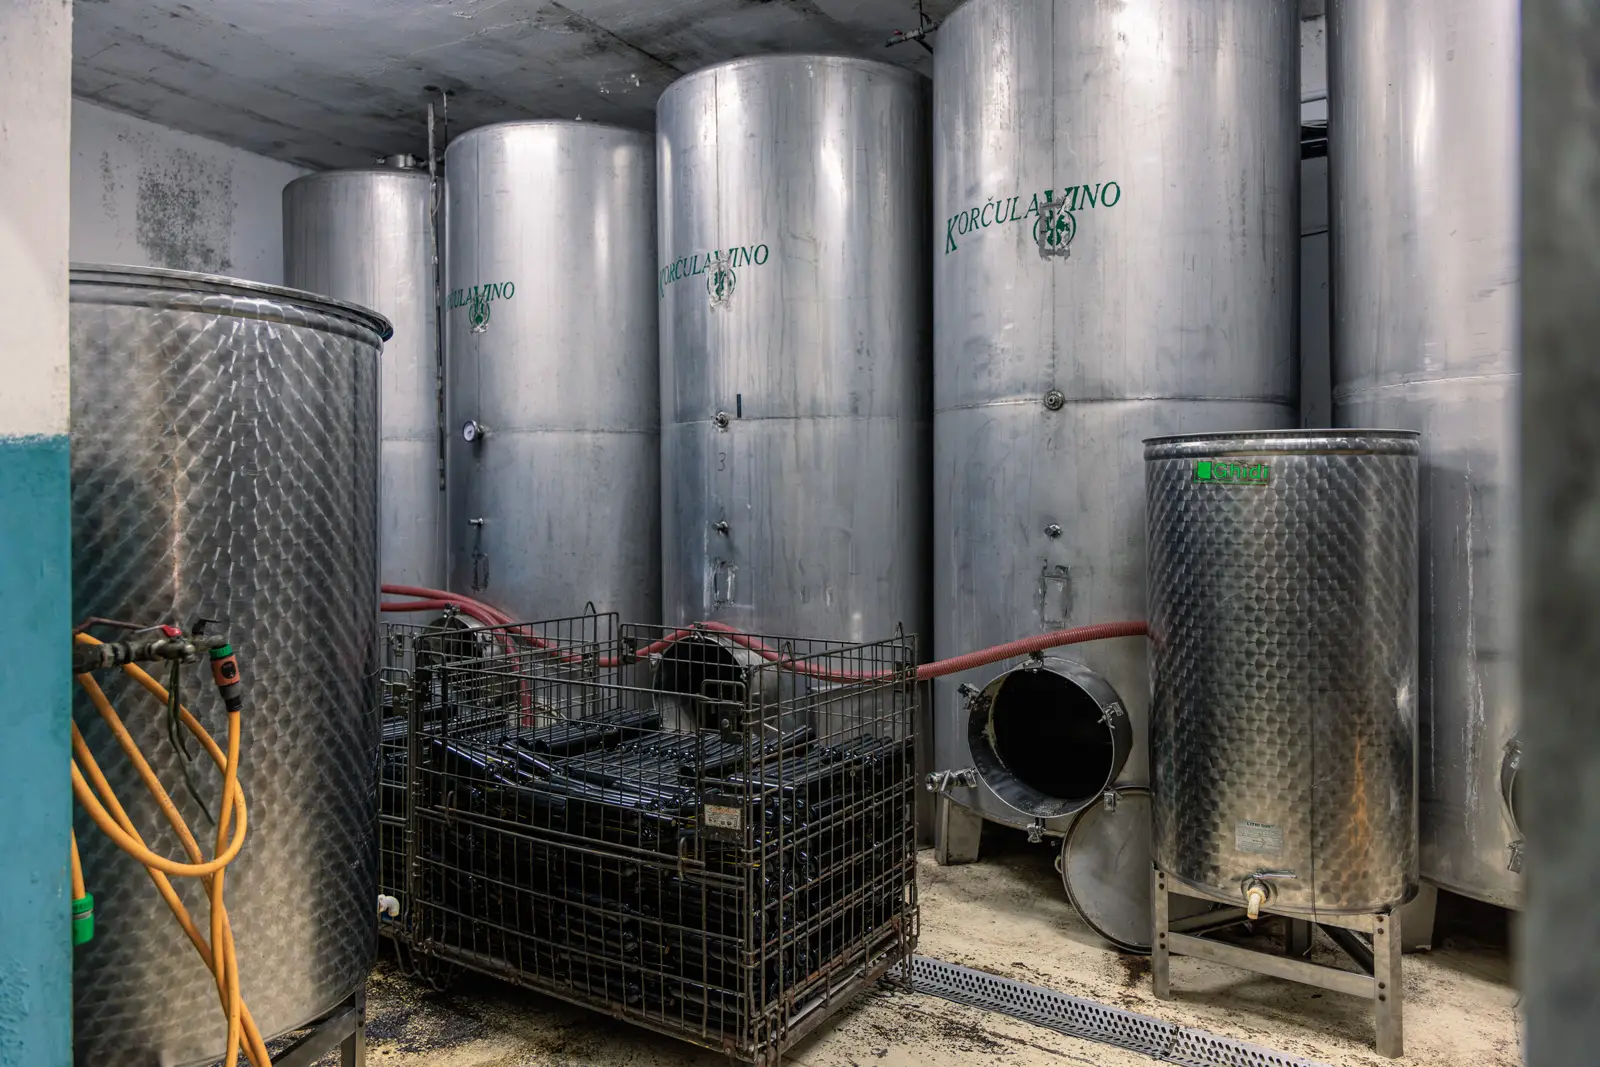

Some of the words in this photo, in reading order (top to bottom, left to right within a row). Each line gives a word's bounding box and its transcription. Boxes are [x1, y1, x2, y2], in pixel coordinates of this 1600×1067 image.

[945, 193, 1041, 255] KORČULA
[717, 452, 727, 472] 3
[1213, 462, 1269, 479] Ghidi
